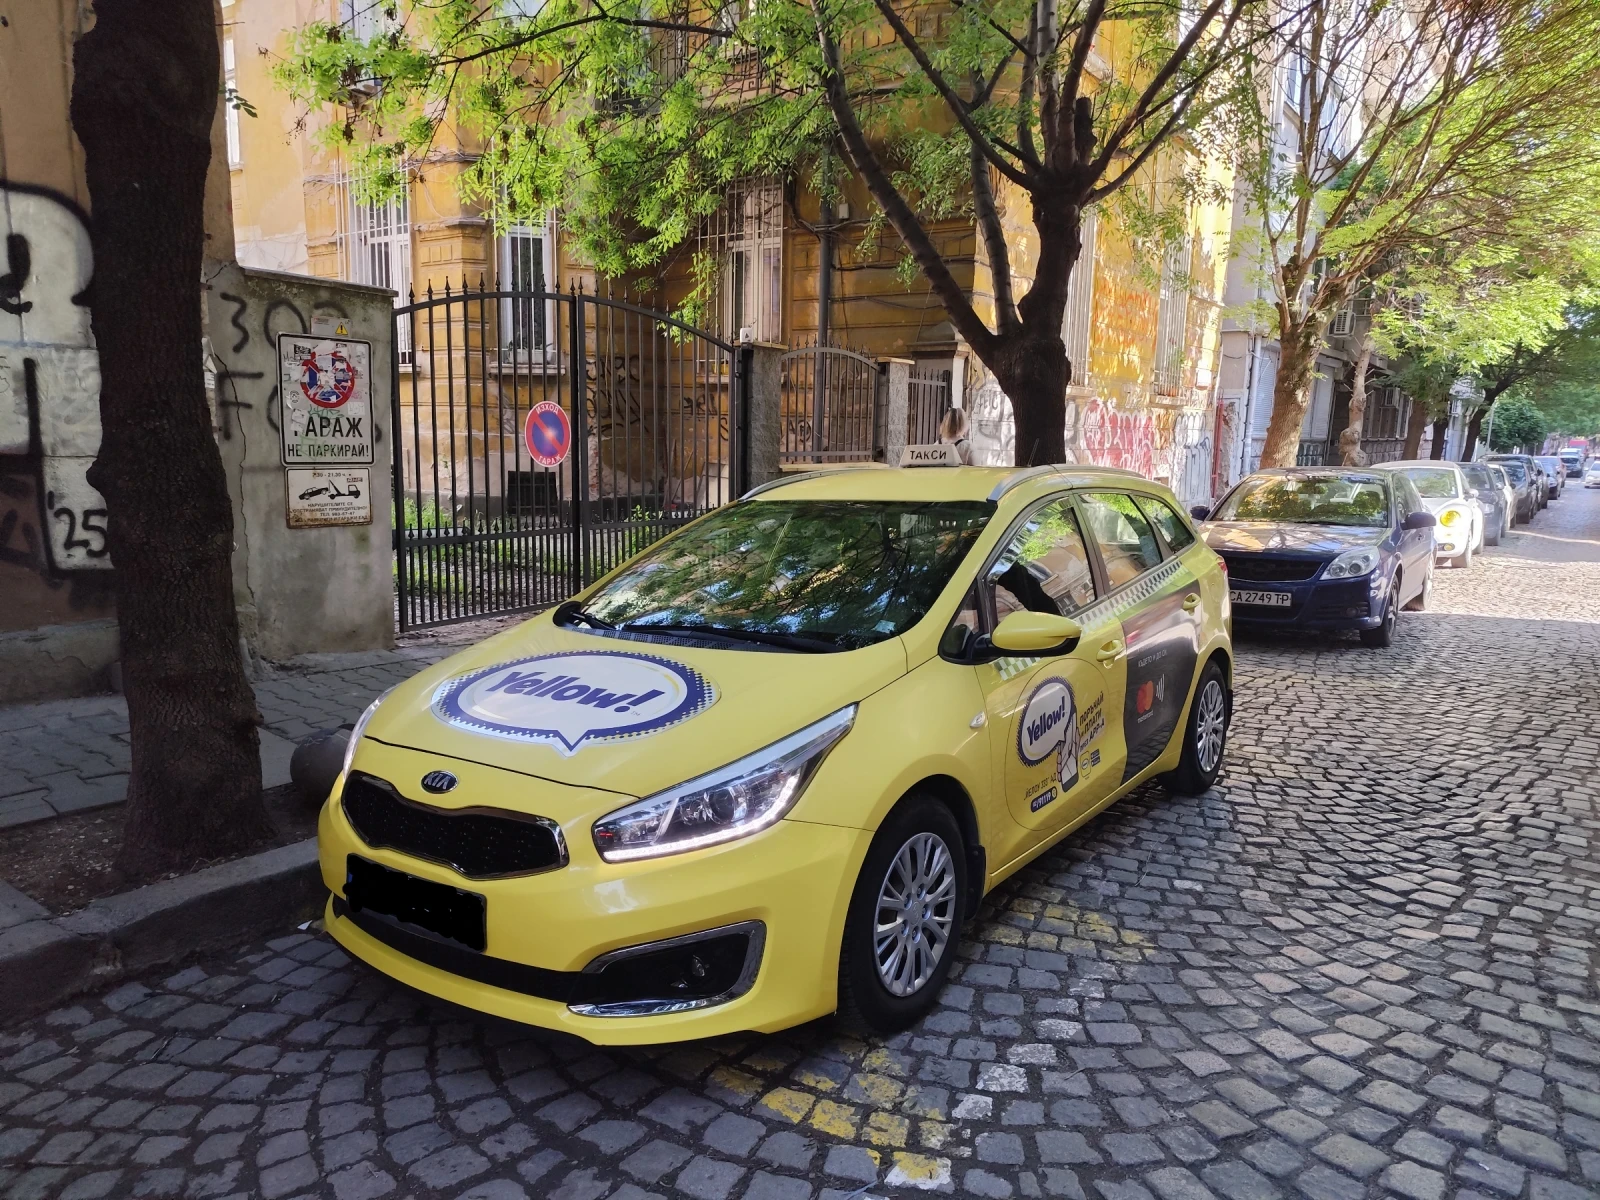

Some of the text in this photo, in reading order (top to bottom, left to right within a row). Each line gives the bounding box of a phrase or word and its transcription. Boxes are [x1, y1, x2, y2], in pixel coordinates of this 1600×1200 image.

[536, 403, 559, 415] ИЗХОД
[294, 416, 363, 438] АРАЖ
[287, 443, 369, 457] НЕ ПАРКИРАЙ!
[909, 450, 947, 460] ТАКСИ
[538, 454, 561, 465] ГАРАЖ
[1244, 592, 1272, 604] 2749
[485, 671, 666, 713] Yellow!
[1026, 695, 1066, 746] Yellow!
[423, 772, 452, 790] KIA
